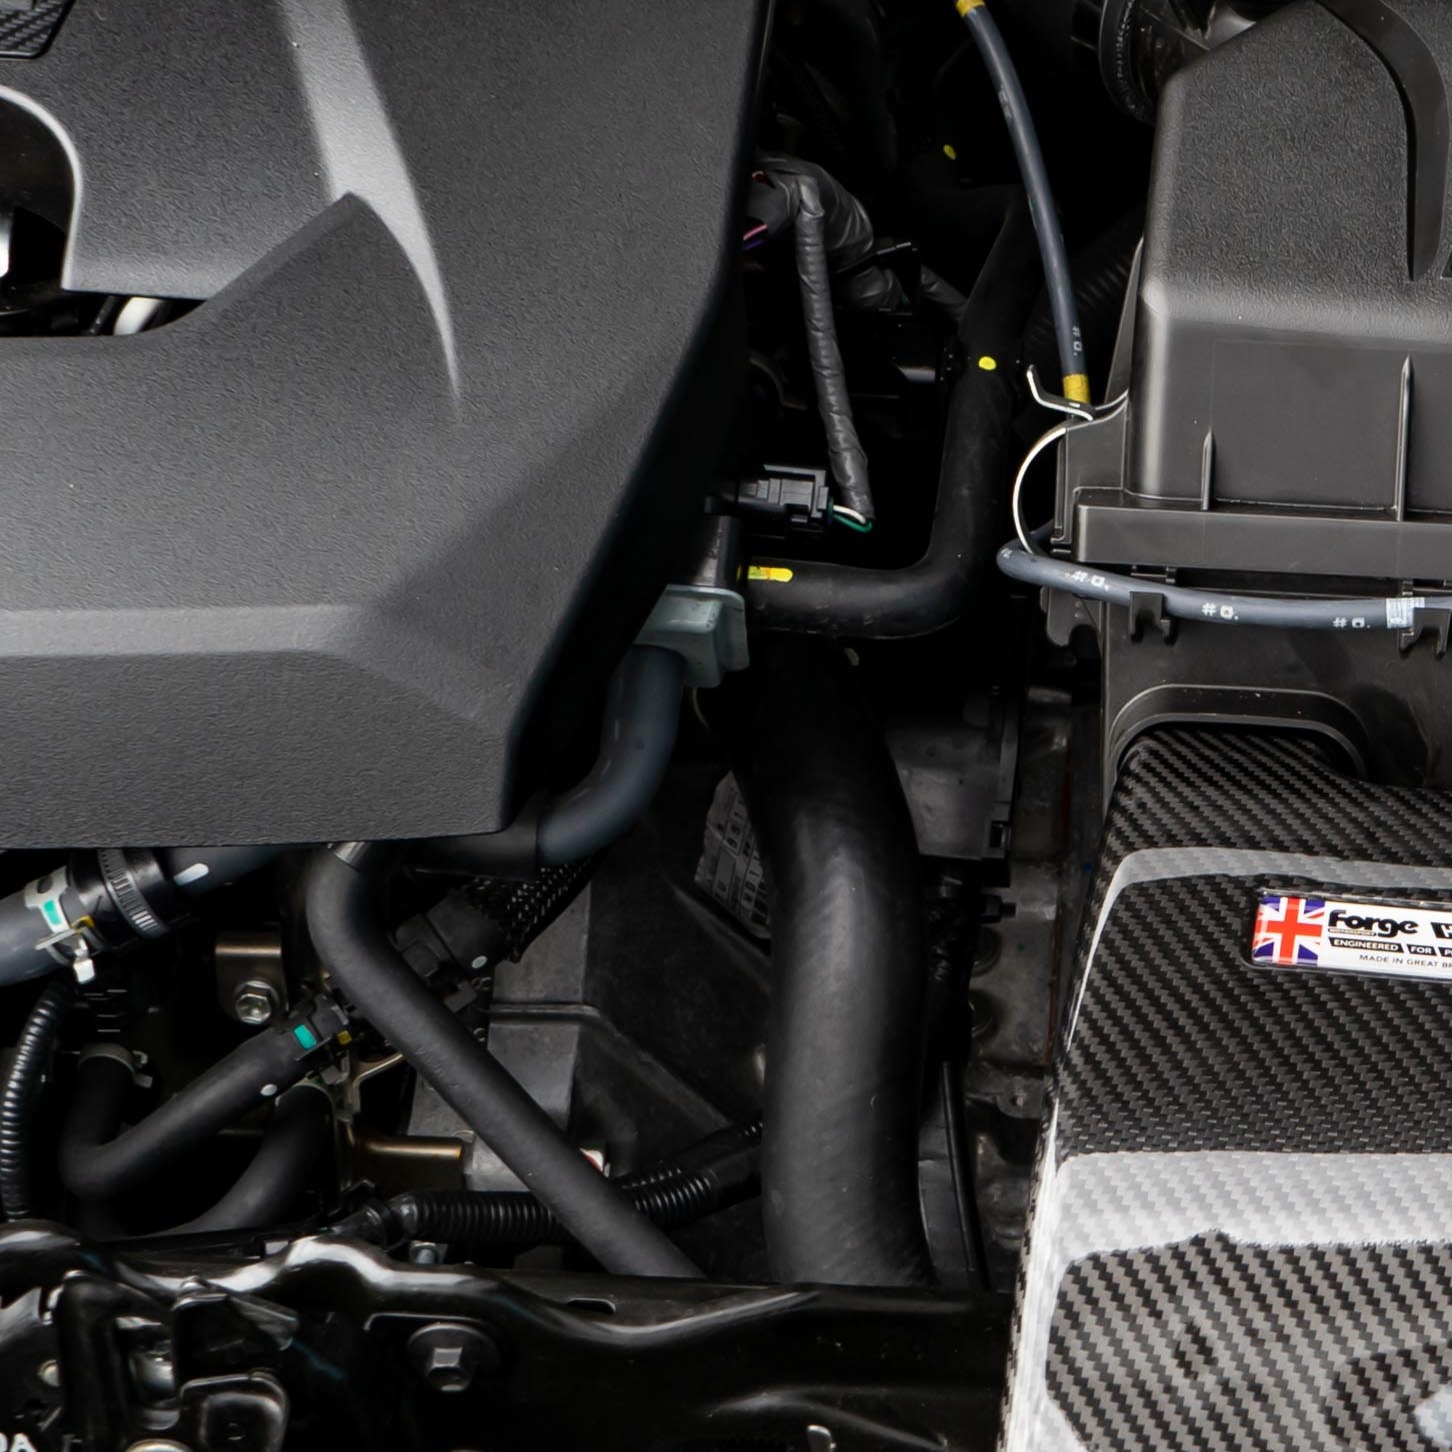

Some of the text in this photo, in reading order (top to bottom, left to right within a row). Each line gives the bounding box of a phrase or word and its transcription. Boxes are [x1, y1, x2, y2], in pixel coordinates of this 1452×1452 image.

[1328, 910, 1419, 938] Forge
[1333, 938, 1399, 952] ENGINEERED
[1410, 946, 1433, 955] FOR
[1360, 954, 1388, 963] MADE
[1393, 957, 1403, 965] IN
[1407, 959, 1438, 968] GREAT
